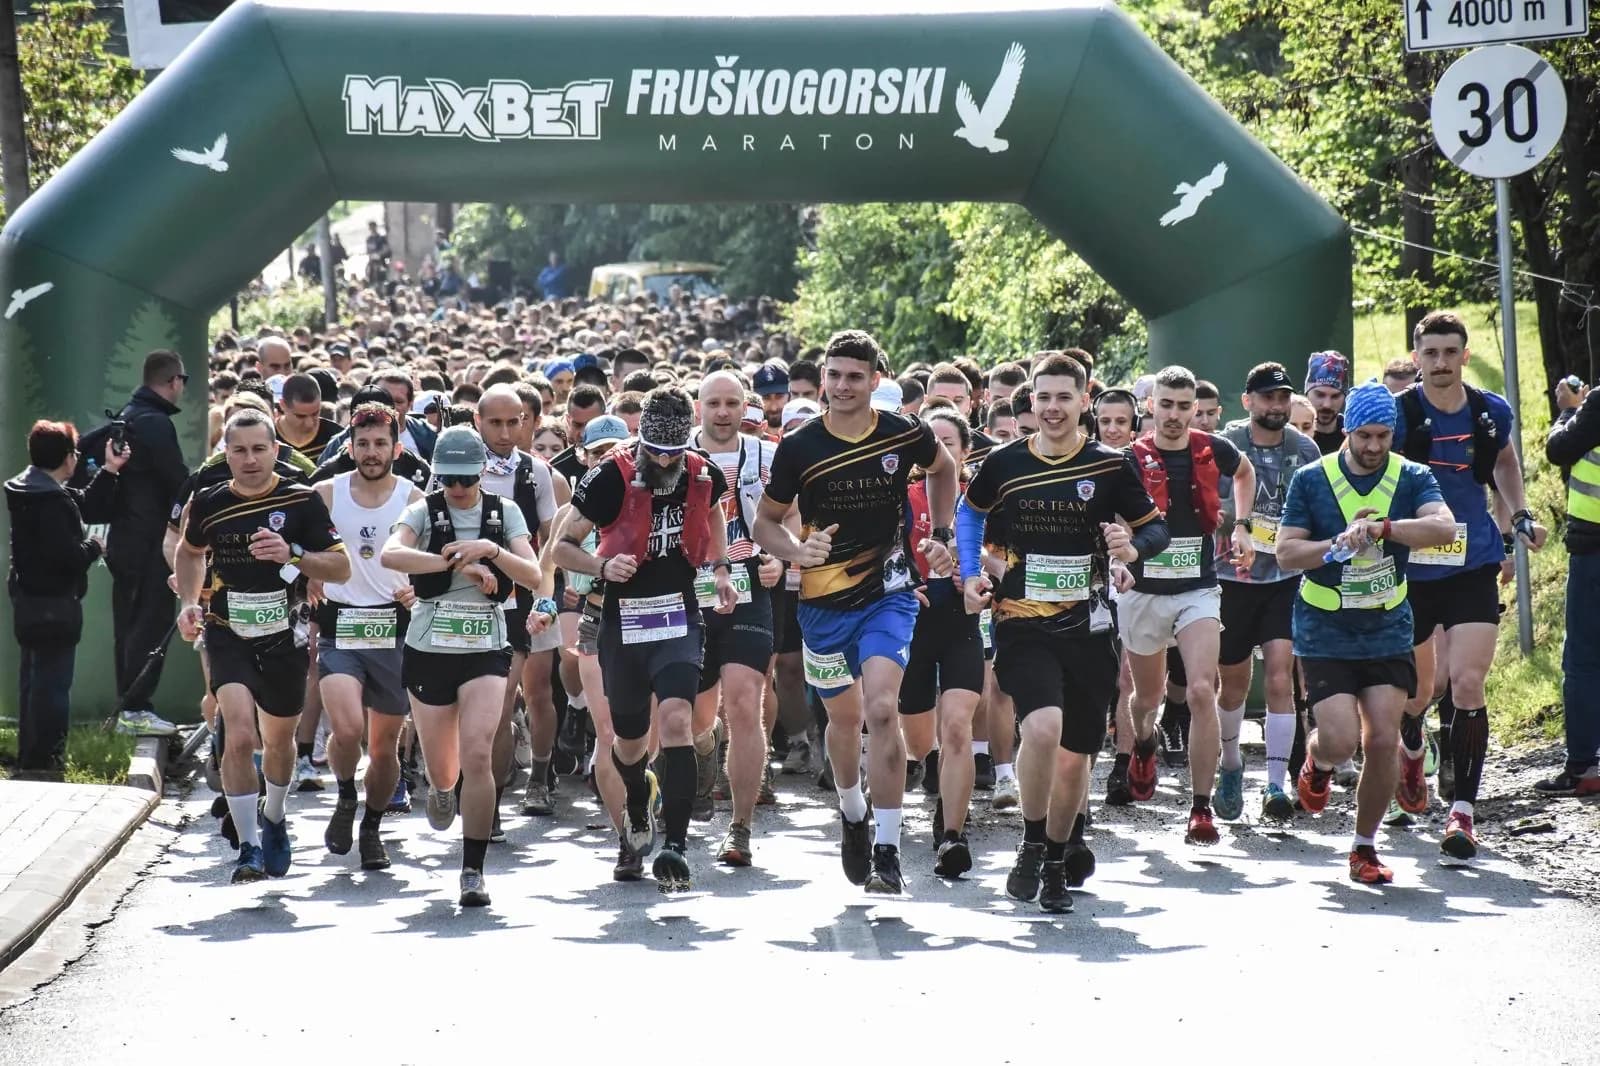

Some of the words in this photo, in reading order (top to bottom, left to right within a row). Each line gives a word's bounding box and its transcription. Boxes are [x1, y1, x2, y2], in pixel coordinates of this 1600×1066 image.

[1447, 0, 1513, 28] 4000
[1524, 0, 1545, 21] m
[626, 55, 947, 117] FRUŠKOGORSKI
[1458, 77, 1538, 148] 30
[659, 133, 916, 152] MARATON
[827, 480, 855, 493] OCR
[859, 475, 894, 489] TEAM
[1019, 498, 1045, 510] OCR
[1051, 500, 1088, 512] TEAM
[1171, 552, 1198, 567] 696
[1055, 573, 1087, 589] 603
[1370, 574, 1395, 594] 630
[255, 606, 286, 624] 629
[662, 612, 671, 627] 1
[363, 624, 393, 638] 607
[462, 619, 489, 635] 615
[815, 666, 847, 679] 722
